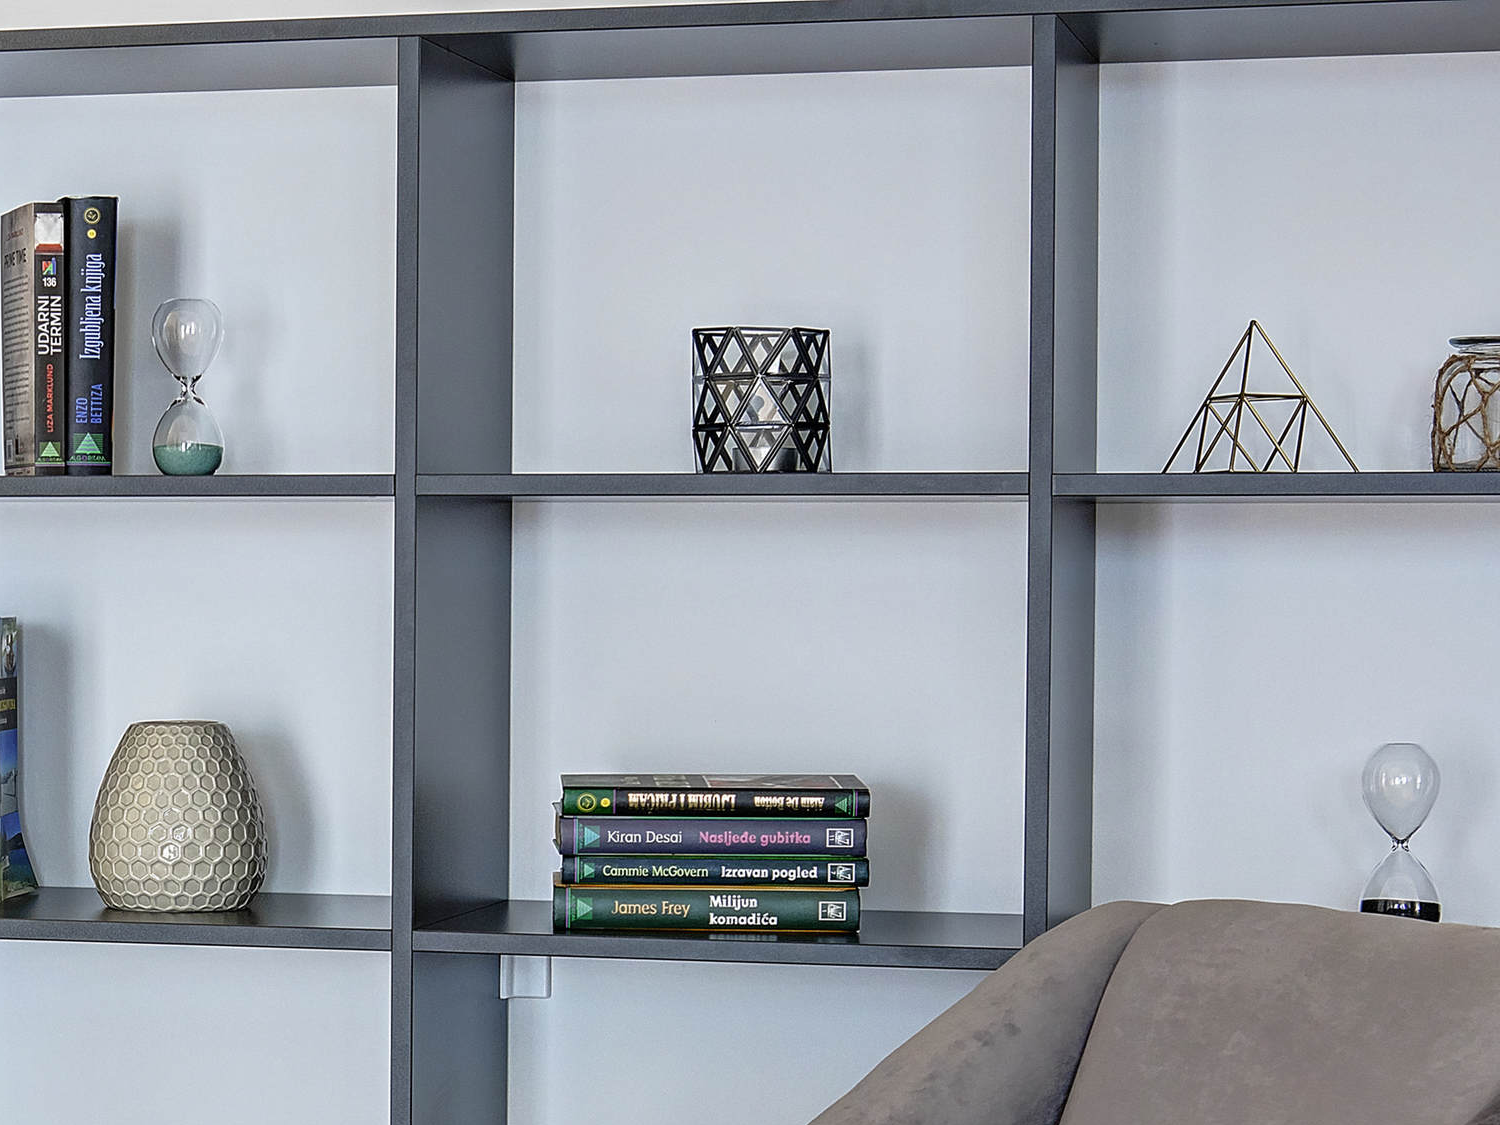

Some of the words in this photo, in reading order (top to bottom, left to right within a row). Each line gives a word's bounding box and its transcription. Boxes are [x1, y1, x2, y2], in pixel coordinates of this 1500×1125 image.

[80, 253, 105, 292] knjiga
[42, 277, 57, 287] 136
[38, 295, 50, 355] UDARNI
[50, 295, 62, 355] TERMIN
[80, 295, 104, 360] Izgubljena
[75, 398, 88, 424] ENZO
[90, 383, 103, 424] BETTIZA
[627, 793, 677, 813] PRIČAM
[678, 793, 686, 811] I
[688, 793, 737, 811] LJUBIM
[754, 796, 785, 811] Botton
[785, 796, 799, 811] De
[800, 796, 825, 811] Alain
[607, 831, 642, 844] Kiran
[645, 831, 683, 844] Desai
[699, 831, 757, 847] Nasljeđe
[760, 831, 811, 847] gubitka
[602, 865, 649, 877] Cammie
[651, 865, 709, 877] McGovern
[771, 866, 818, 883] pogled
[612, 900, 657, 915] James
[661, 901, 691, 918] Frey
[709, 895, 758, 910] Milijun
[709, 910, 778, 926] komadića
